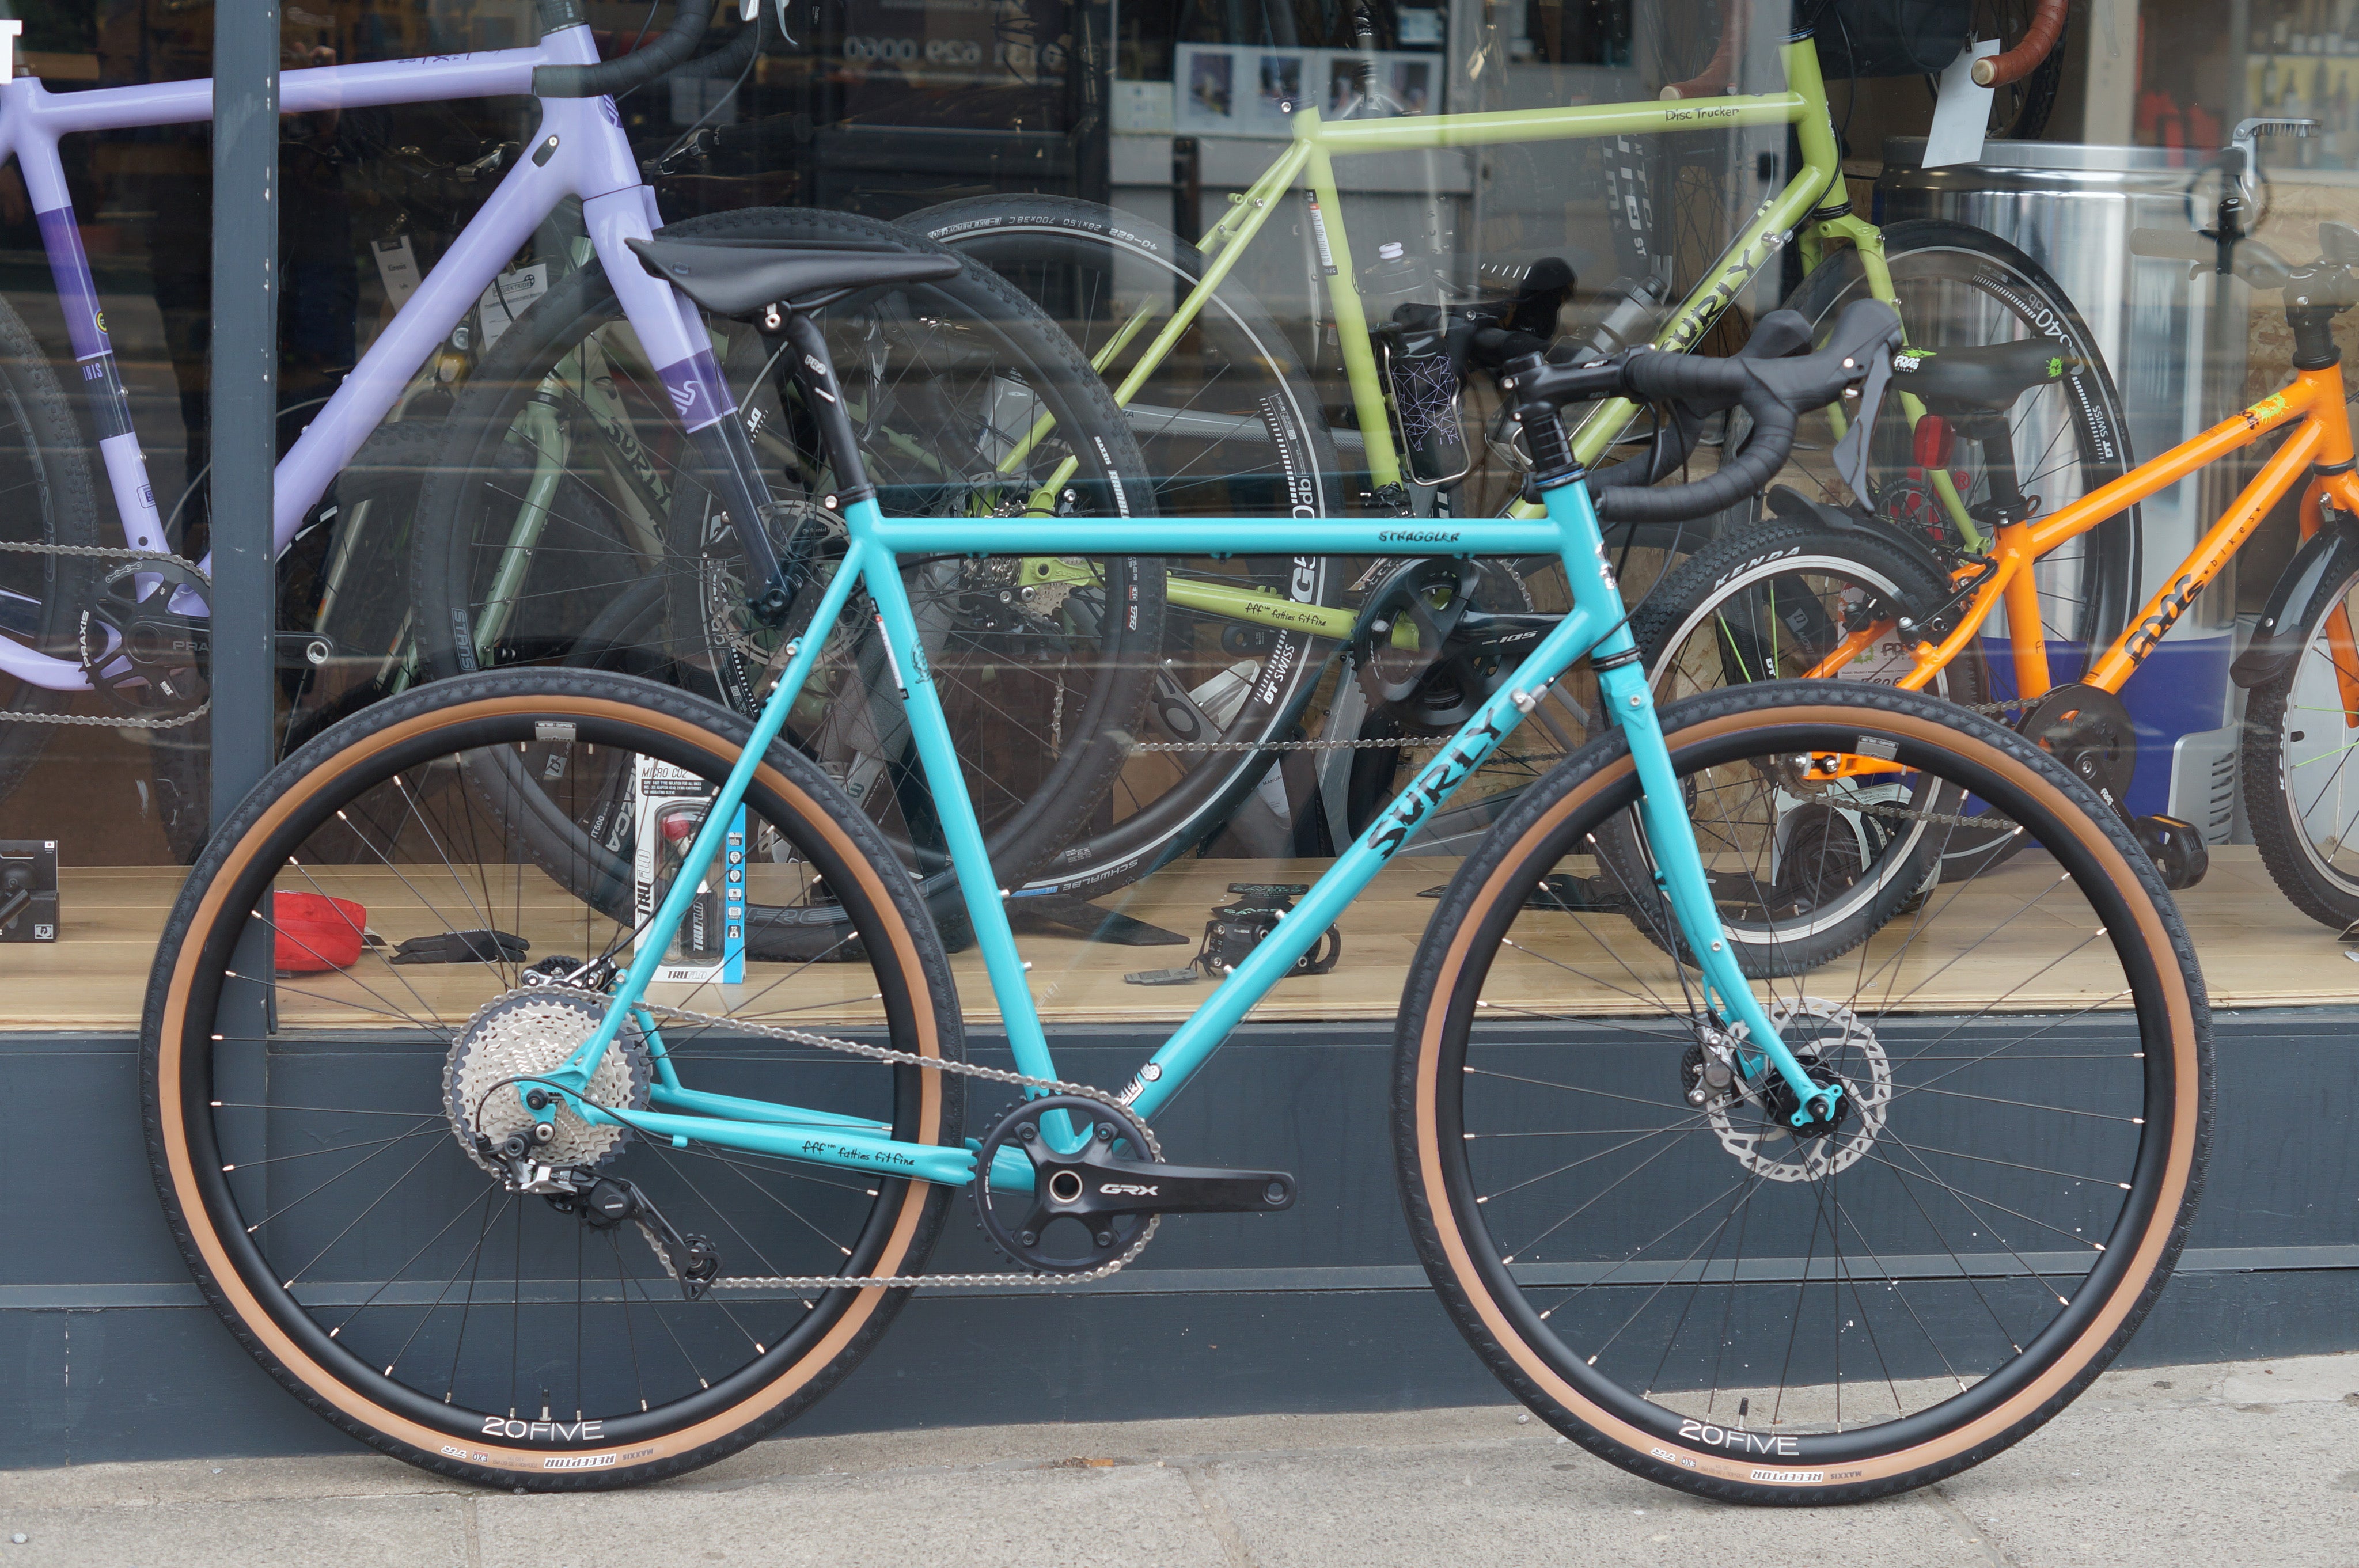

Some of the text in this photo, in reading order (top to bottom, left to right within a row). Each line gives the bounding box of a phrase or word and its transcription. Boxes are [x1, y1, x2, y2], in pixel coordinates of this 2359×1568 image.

[1666, 108, 1740, 122] Disc Trucker
[1064, 219, 1101, 231] 28x1.50
[1109, 227, 1158, 250] 40-622
[83, 363, 103, 381] IBIS
[805, 354, 826, 375] PRO
[2092, 405, 2108, 438] SWISS
[2103, 441, 2114, 458] DT
[1094, 436, 1130, 518] MAXXIS RAMBL
[1379, 530, 1461, 542] STRAGGLER
[1713, 546, 1800, 591] KENDA
[1272, 609, 1295, 621] fatties
[2125, 574, 2204, 669] FROG
[78, 609, 90, 669] PRAXIS
[453, 610, 475, 670] STANS
[1500, 630, 1538, 643] 105
[173, 640, 210, 652] PRA
[1263, 643, 1295, 705] DT SWISS
[1765, 657, 1776, 677] DT
[642, 767, 688, 779] MICRO CO2
[1262, 774, 1283, 786] MANUAL
[1367, 707, 1503, 861] SURLY
[590, 815, 605, 839] IT500
[1063, 859, 1139, 891] SCHWALBE
[637, 849, 651, 922] TRUFLO
[693, 902, 704, 951] TRUFLO
[667, 971, 707, 979] TRUFLO
[838, 1147, 870, 1161] fatties
[1099, 1183, 1159, 1196] GRX
[481, 1415, 604, 1441] 20FIVE
[1678, 1419, 1800, 1456] 20FIVE
[472, 1451, 488, 1463] EXO
[543, 1453, 617, 1469] RECEPTOR
[622, 1448, 654, 1460] MAXXIS
[1681, 1455, 1697, 1468] EXO
[1750, 1468, 1824, 1483] RECEPTOR
[1830, 1470, 1863, 1480] MAXXIS
